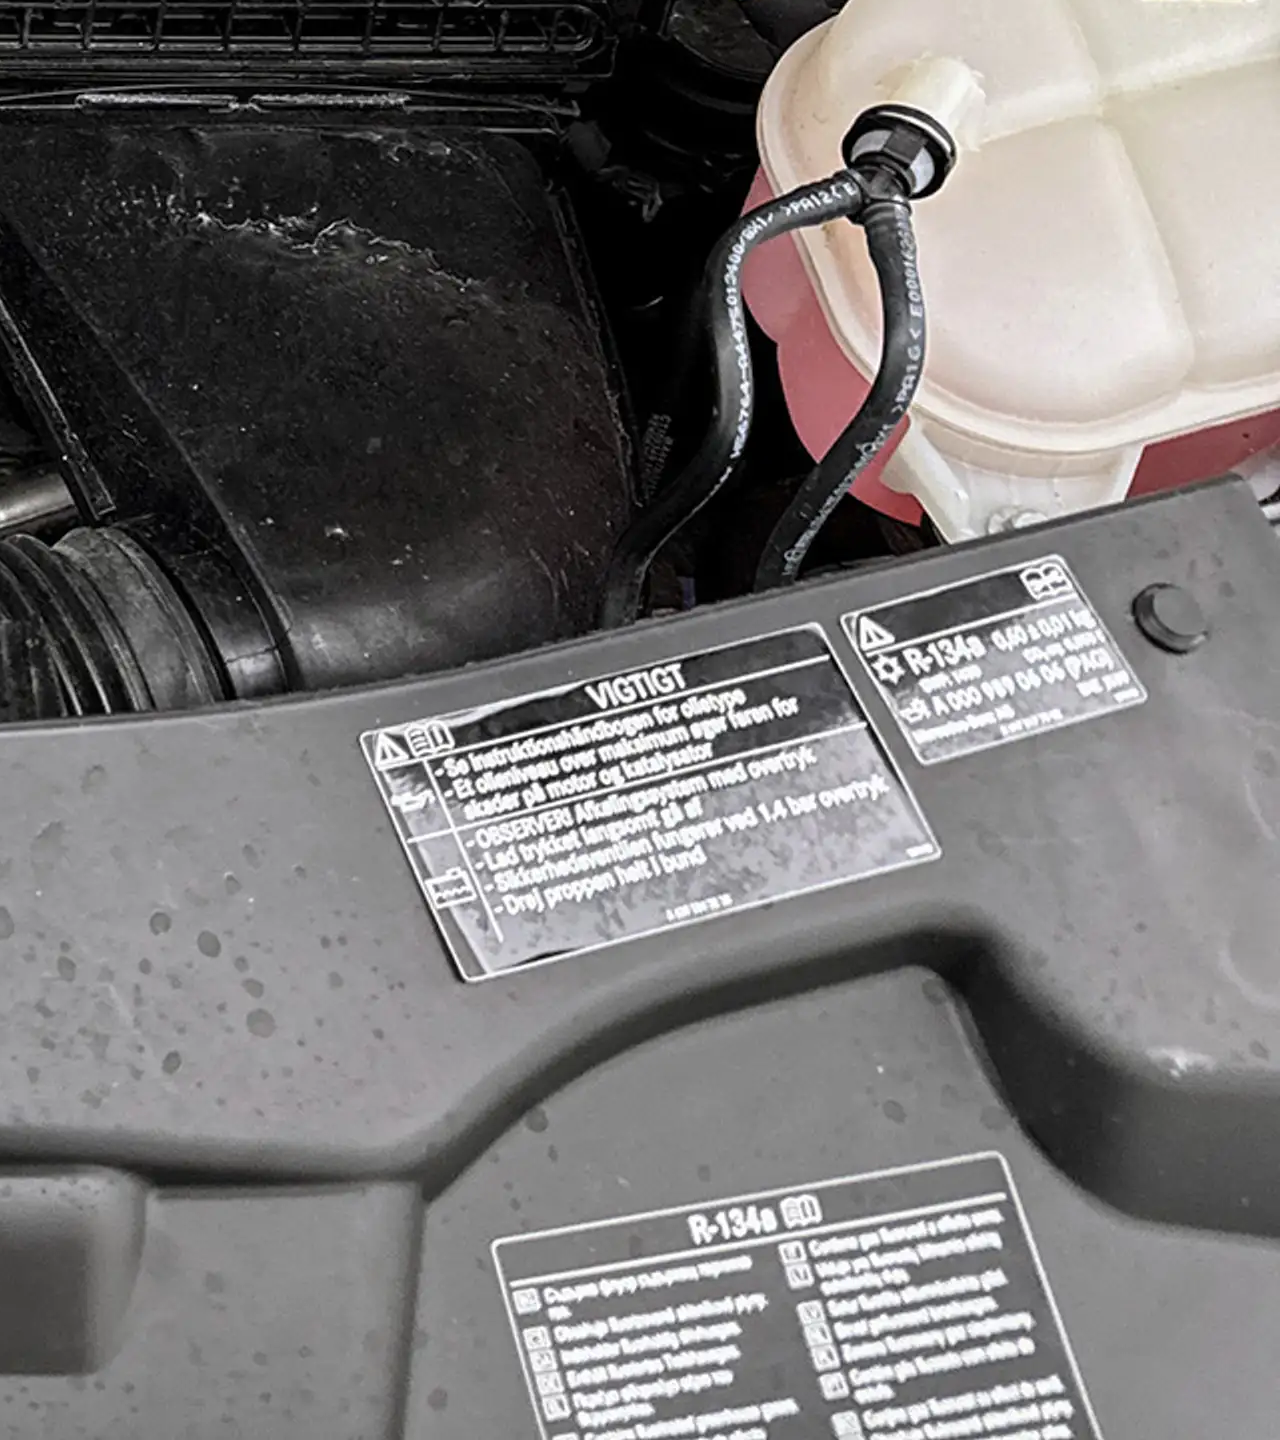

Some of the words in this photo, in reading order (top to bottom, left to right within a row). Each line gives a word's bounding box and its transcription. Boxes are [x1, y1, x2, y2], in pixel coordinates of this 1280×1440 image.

[902, 635, 987, 675] R-134a
[1036, 612, 1073, 638] 0,01
[585, 663, 685, 709] VIGTIGT
[931, 695, 950, 716] A
[945, 685, 983, 711] 000
[652, 705, 678, 725] for
[452, 778, 476, 799] Et
[560, 749, 597, 772] over
[598, 726, 690, 762] maksimum
[772, 697, 798, 717] for
[463, 792, 520, 821] skader
[522, 782, 546, 810] på
[546, 772, 597, 799] motor
[599, 766, 626, 788] og
[620, 742, 713, 779] katalysator
[707, 762, 748, 788] med
[722, 806, 759, 832] ved
[785, 793, 817, 816] bar
[482, 844, 520, 871] Lad
[518, 830, 583, 863] trykket
[579, 809, 661, 845] langsomt
[543, 871, 616, 910] proppen
[613, 860, 653, 886] helt
[658, 844, 707, 873] bund
[688, 1206, 777, 1245] R-134a
